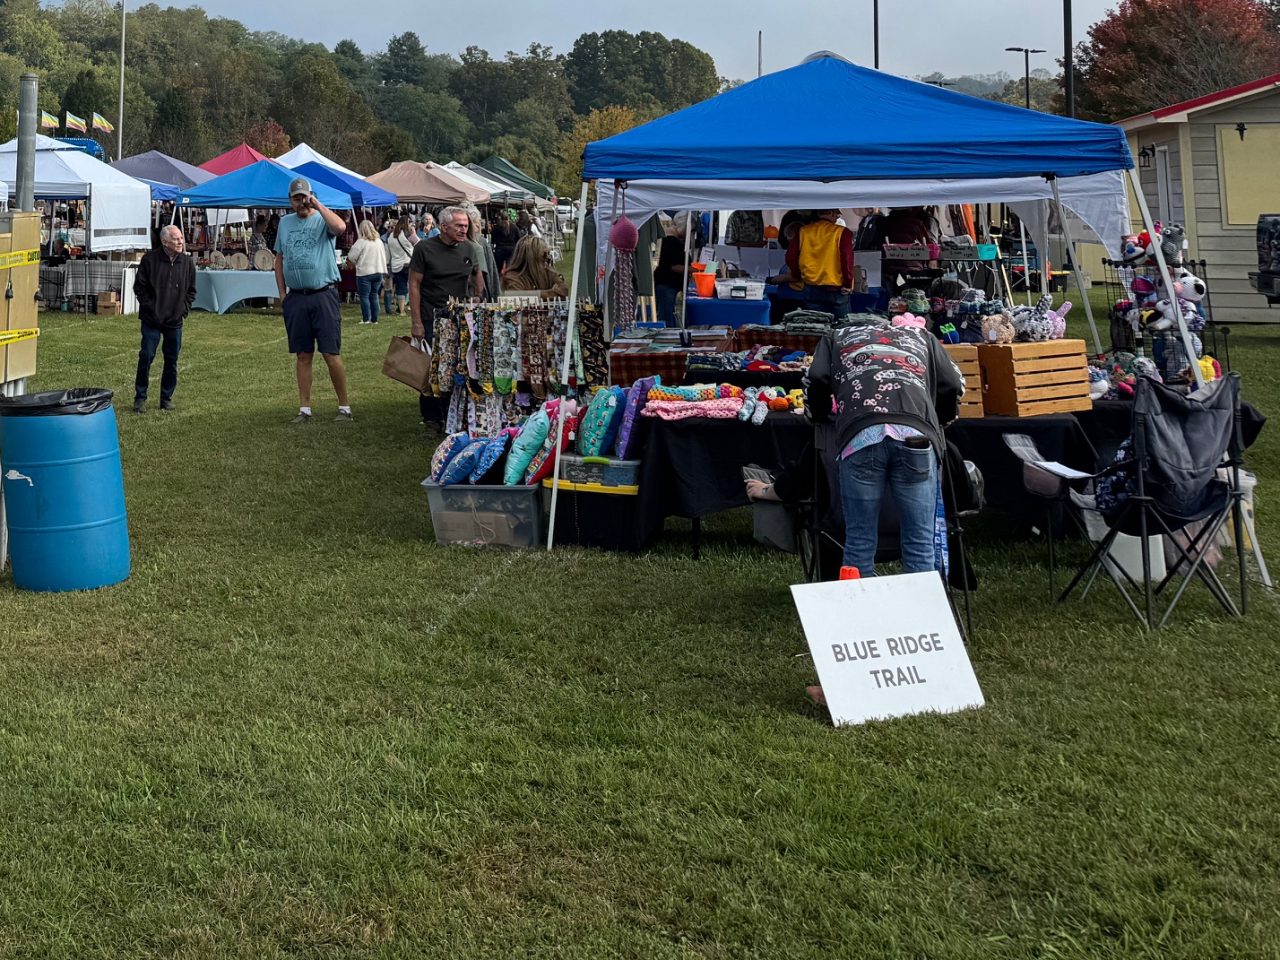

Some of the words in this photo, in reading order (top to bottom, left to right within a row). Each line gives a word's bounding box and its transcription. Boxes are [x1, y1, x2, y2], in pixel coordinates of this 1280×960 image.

[831, 640, 881, 663] BLUE
[885, 633, 944, 656] RIDGE
[869, 665, 927, 689] TRAIL
